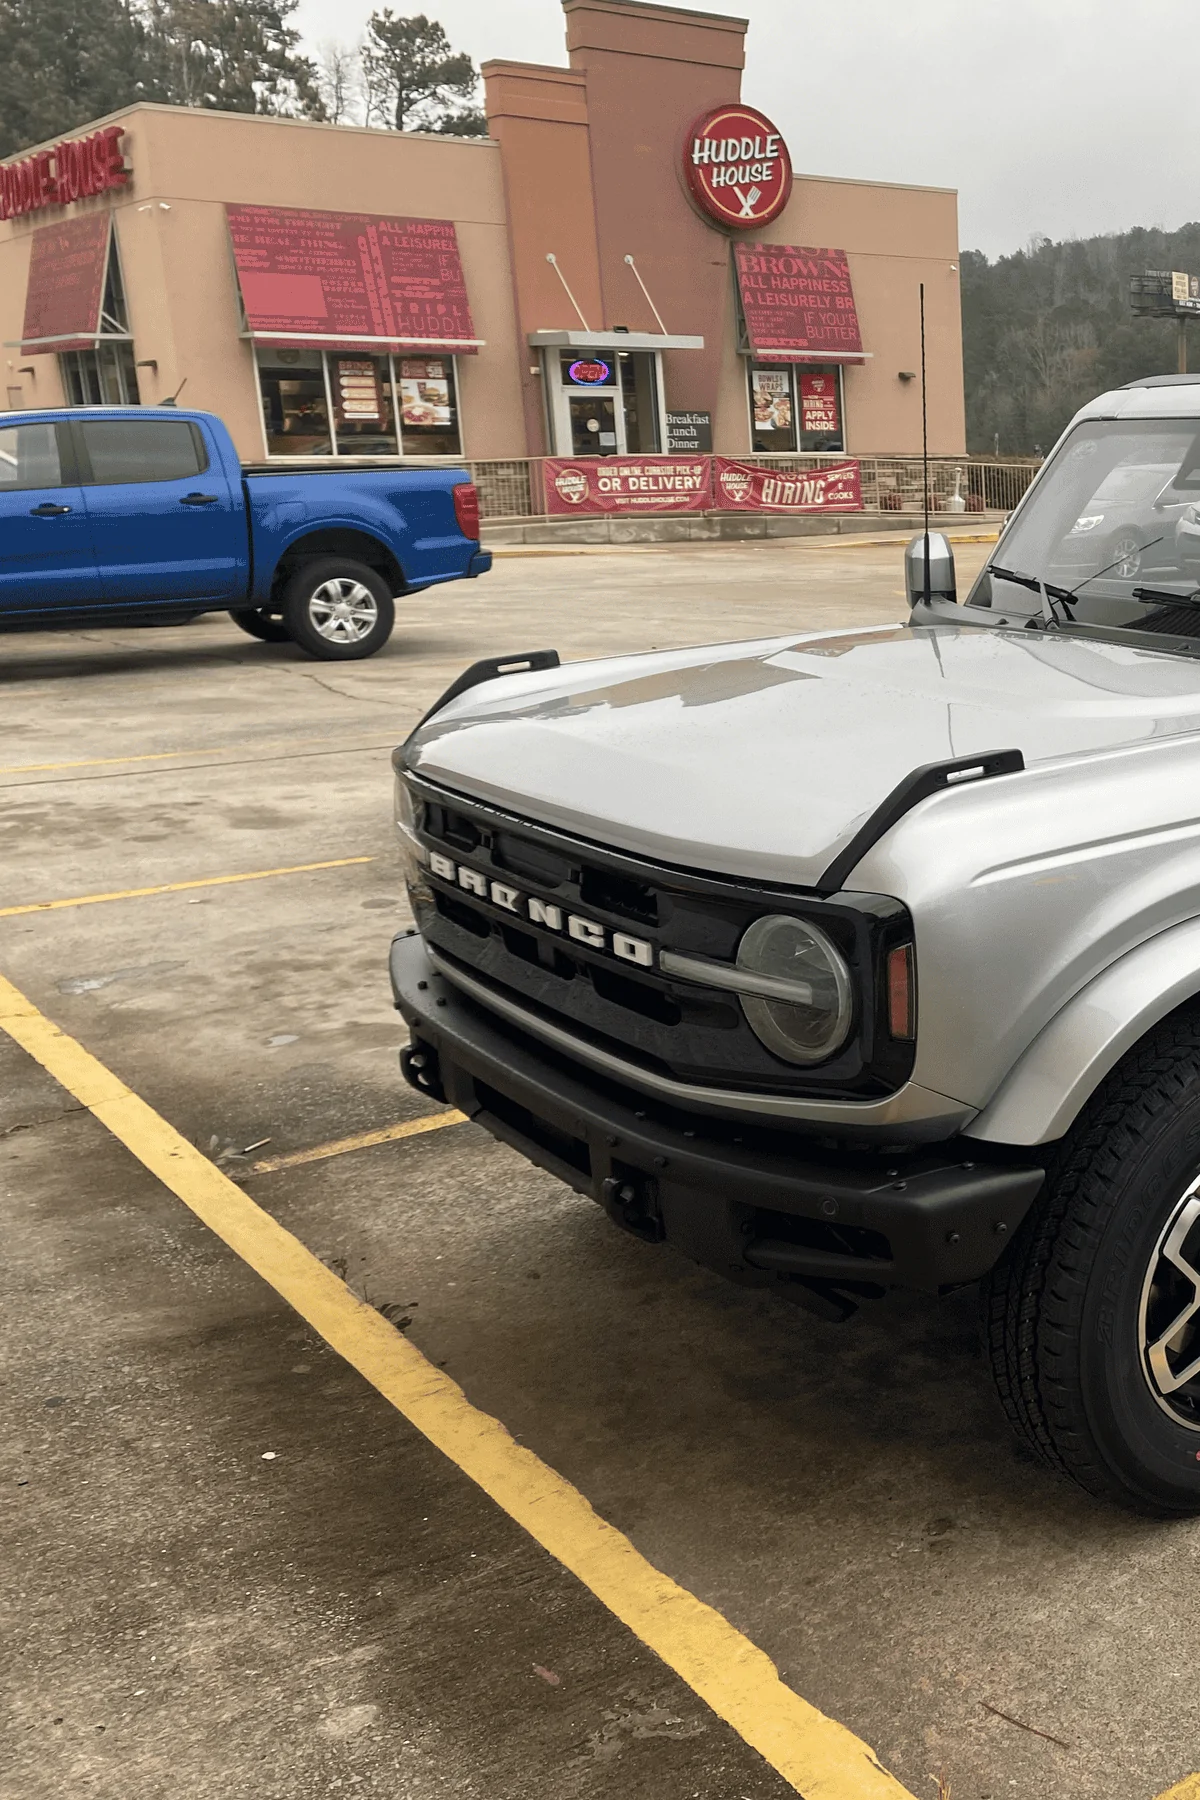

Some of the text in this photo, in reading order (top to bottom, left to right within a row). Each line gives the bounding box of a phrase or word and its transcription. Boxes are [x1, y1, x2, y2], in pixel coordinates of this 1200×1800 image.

[692, 134, 781, 165] HUDDLE
[711, 162, 774, 188] HOUSE
[379, 220, 403, 233] ALL
[382, 235, 390, 246] A
[741, 274, 849, 293] ALL HAPPINESS
[744, 291, 753, 304] A
[758, 292, 831, 308] LEISURELY
[804, 311, 814, 323] IF
[666, 414, 709, 425] Breakfast
[805, 411, 833, 420] APPLY
[666, 426, 697, 437] Lunch
[805, 421, 835, 430] INSIDE
[667, 438, 699, 449] Dinner
[720, 472, 754, 482] HUDDLE
[598, 476, 702, 491] OR DELIVERY
[762, 479, 826, 504] HIRING
[828, 492, 853, 500] COOKS
[429, 851, 653, 967] BRONCO
